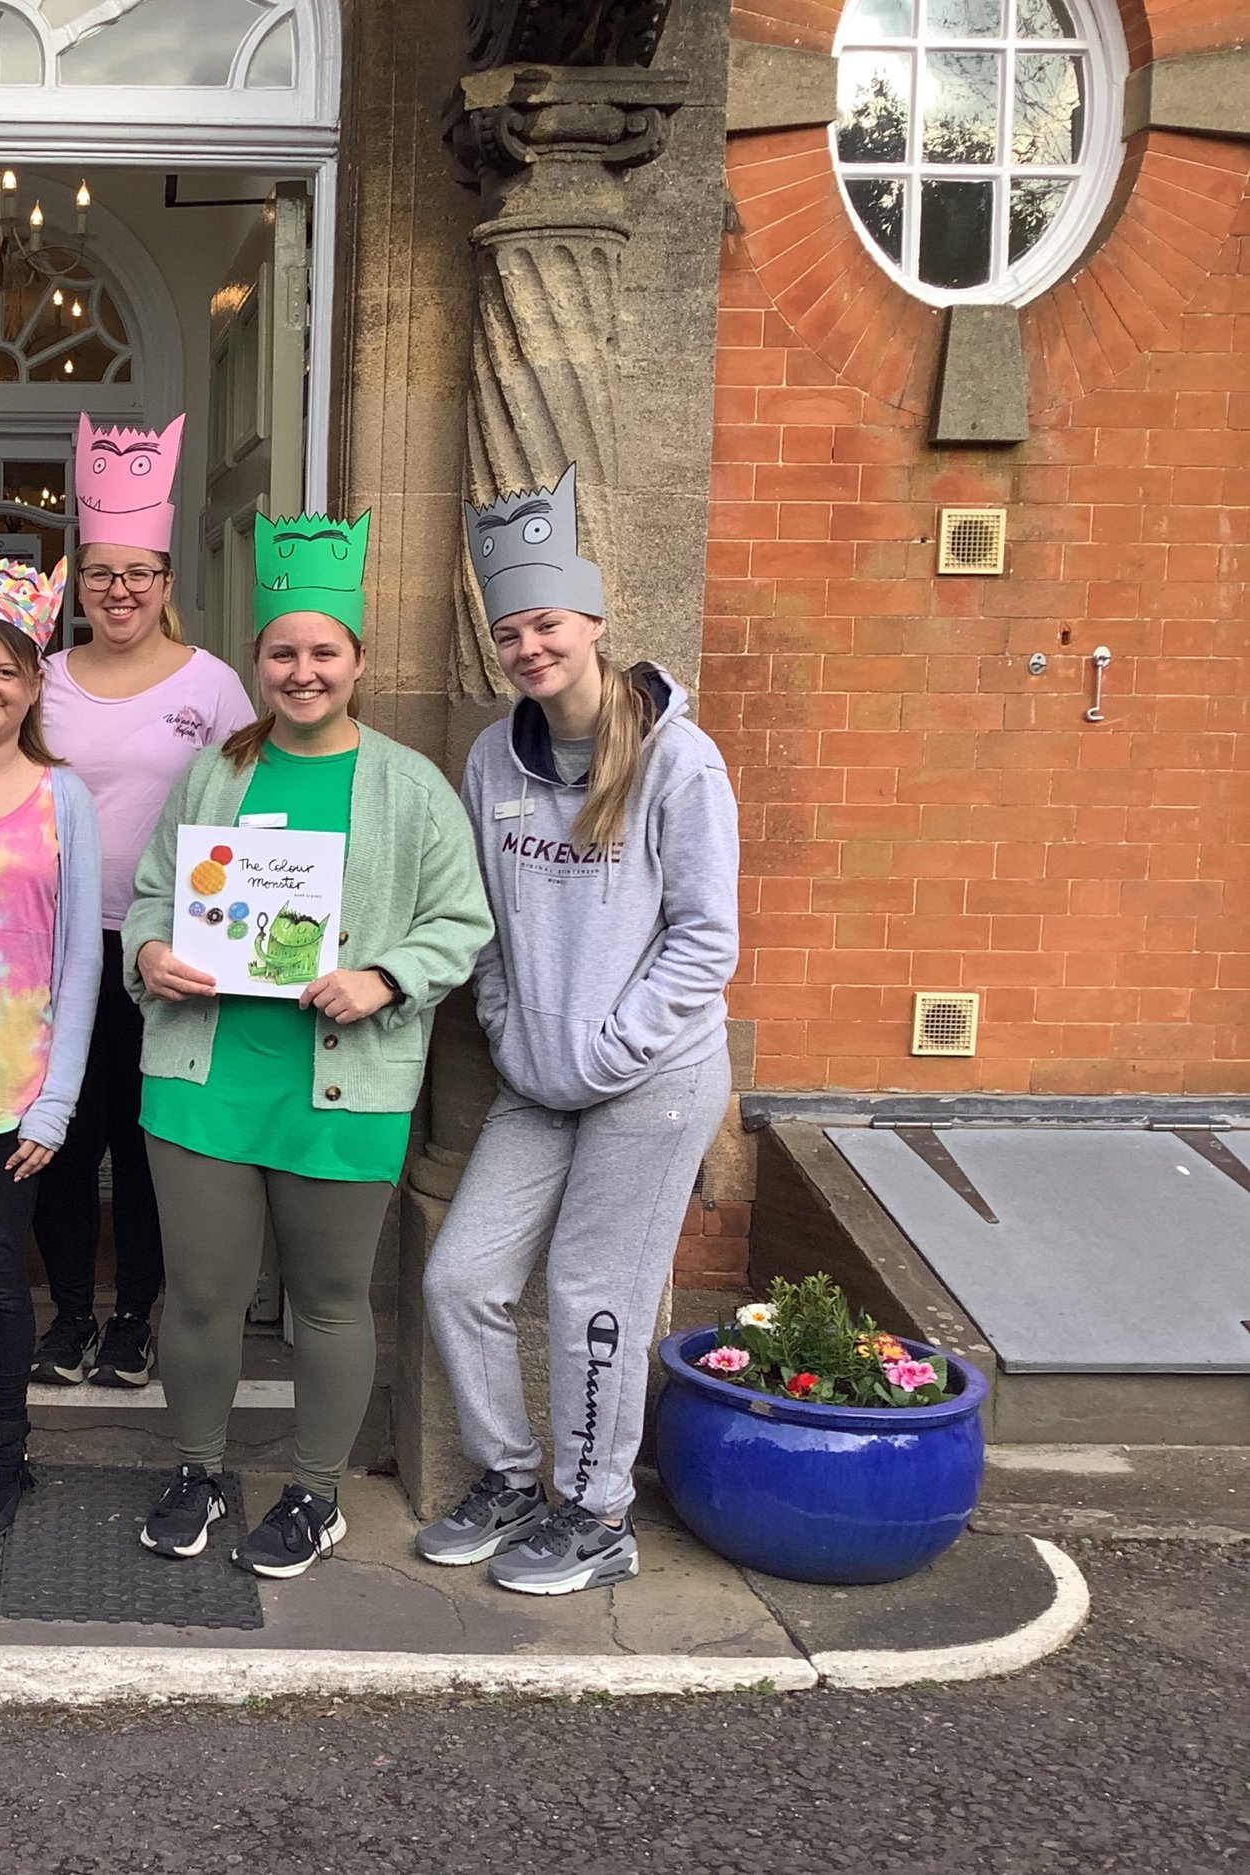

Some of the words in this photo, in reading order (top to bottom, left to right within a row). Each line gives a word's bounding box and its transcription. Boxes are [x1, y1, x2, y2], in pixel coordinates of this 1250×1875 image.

[238, 858, 263, 872] The
[268, 858, 315, 873] Colour
[571, 1310, 619, 1506] Champion
